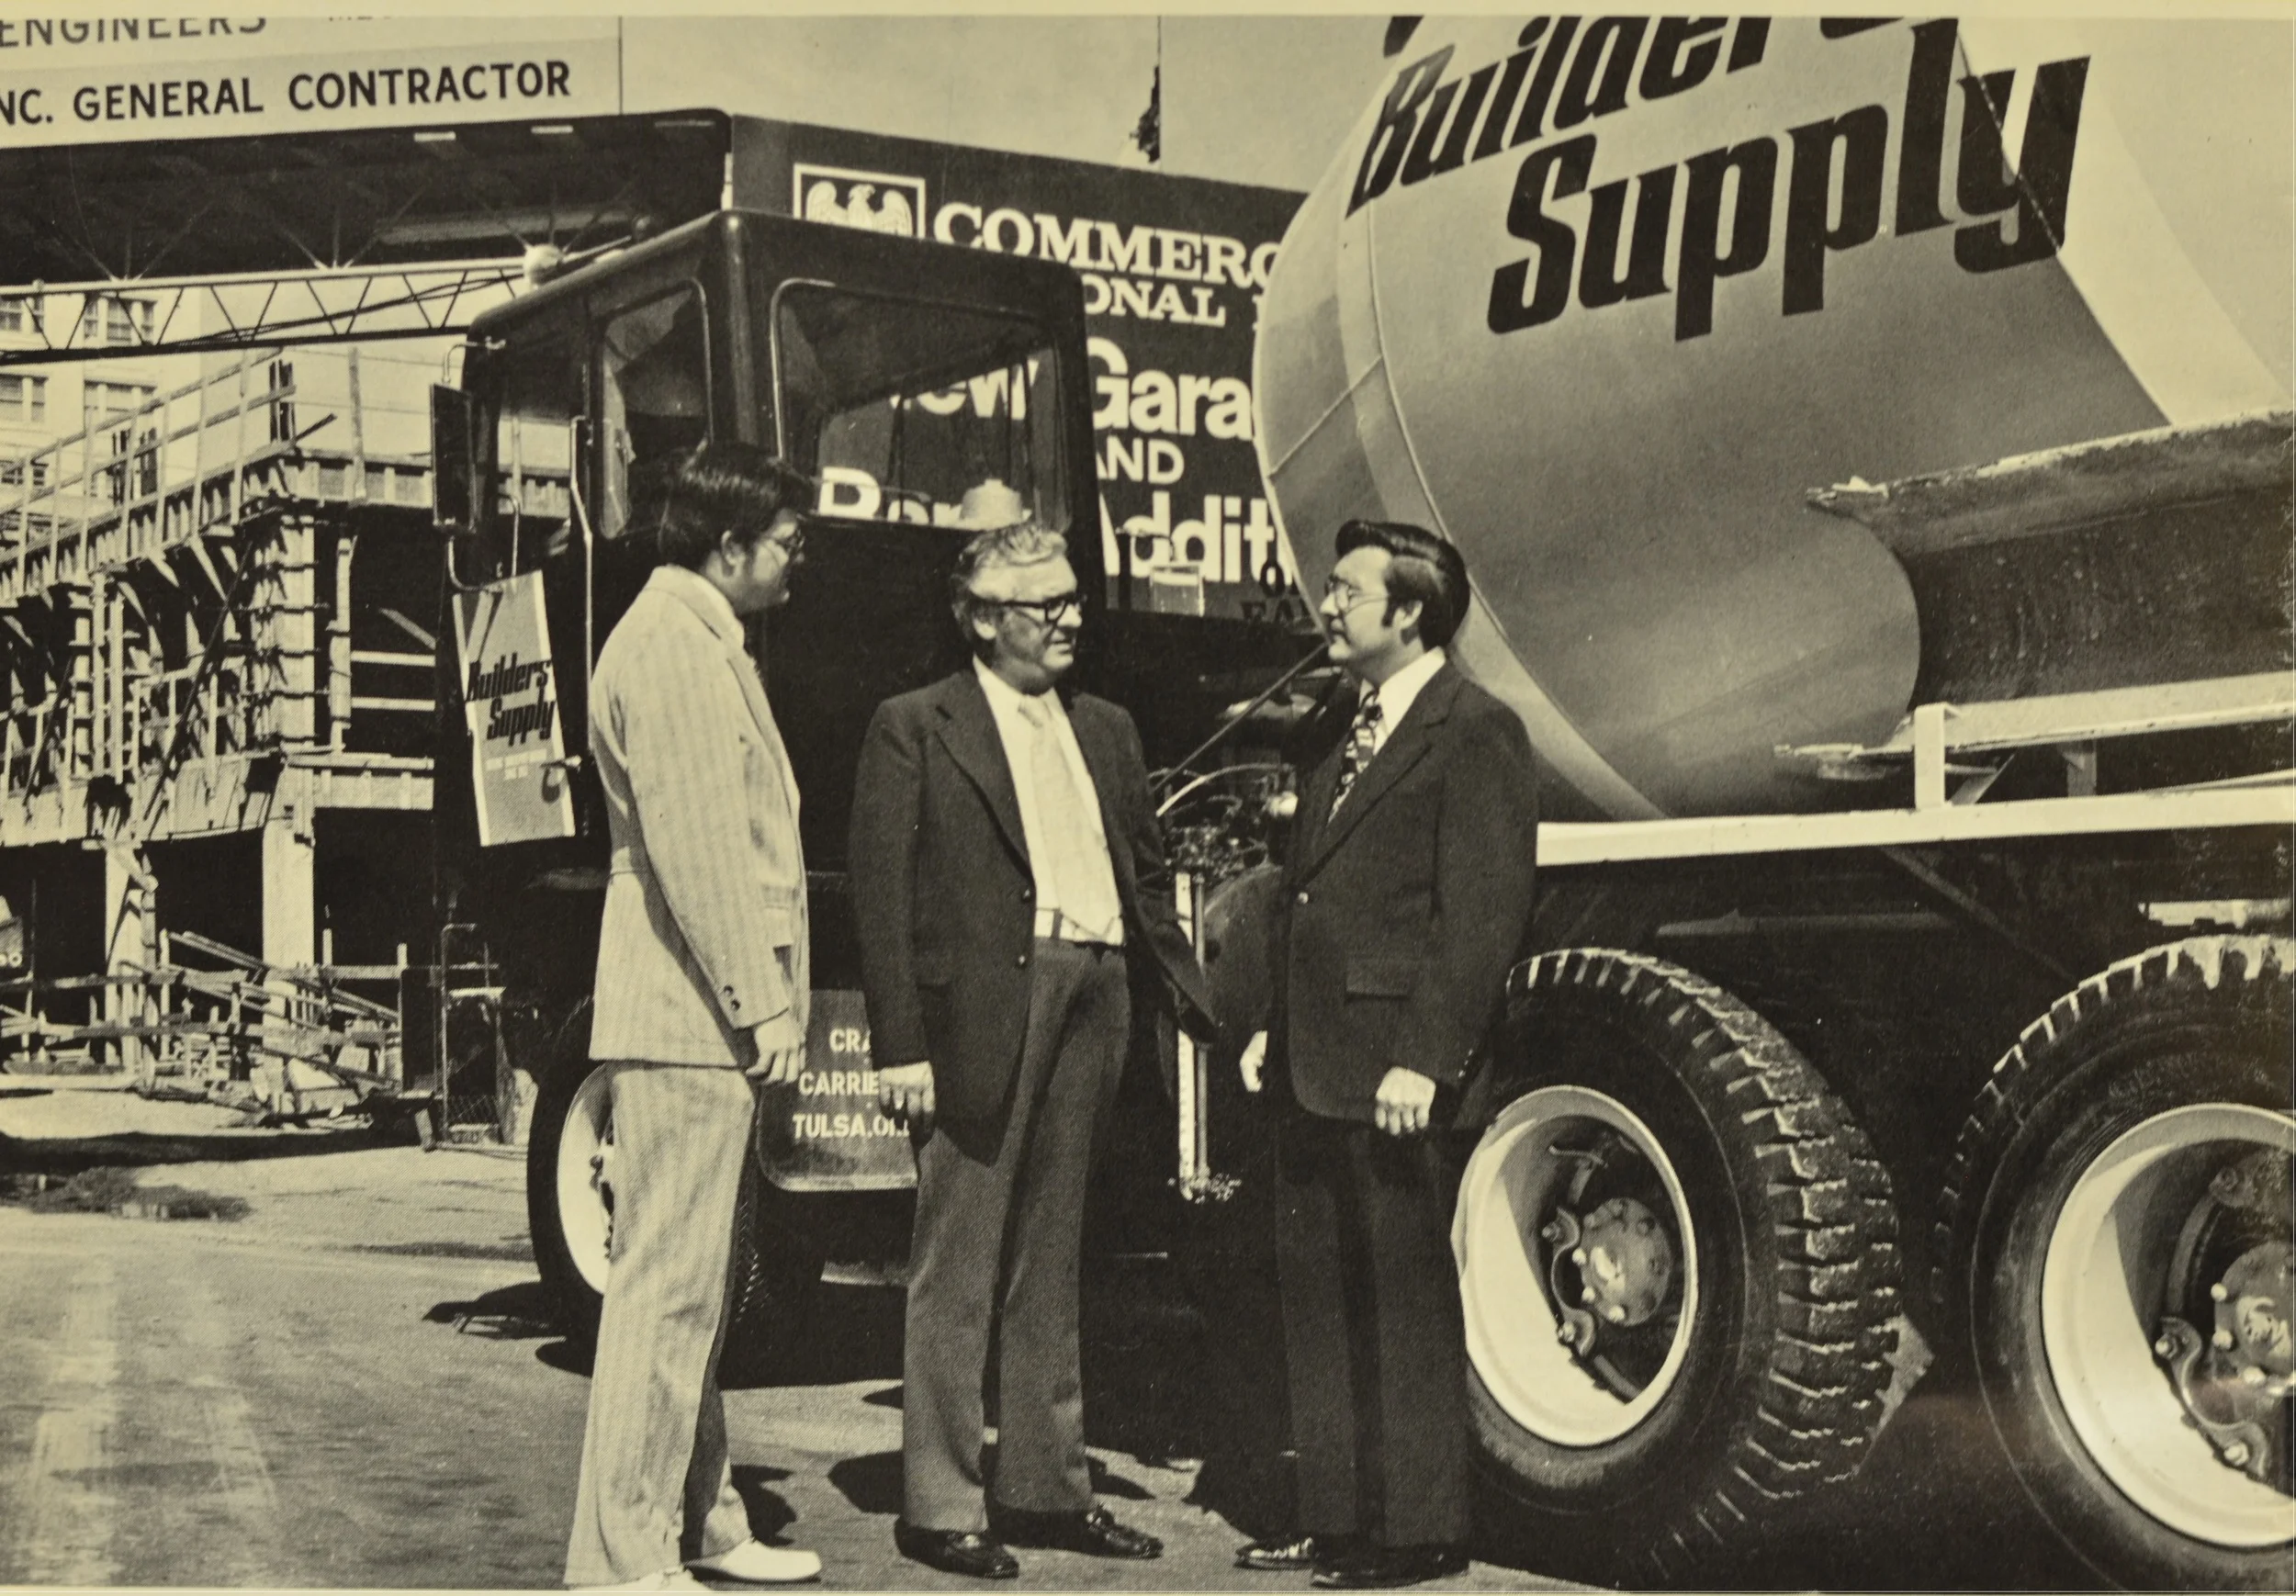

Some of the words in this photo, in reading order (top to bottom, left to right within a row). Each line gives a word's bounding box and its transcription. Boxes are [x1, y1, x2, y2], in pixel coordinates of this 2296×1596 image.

[73, 77, 264, 121] GENERAL
[288, 60, 571, 111] CONTRACTOR
[1345, 16, 1906, 220] Builder
[1488, 17, 2091, 343] Supply
[486, 686, 556, 747] Supply
[797, 1070, 880, 1096] CARRIE
